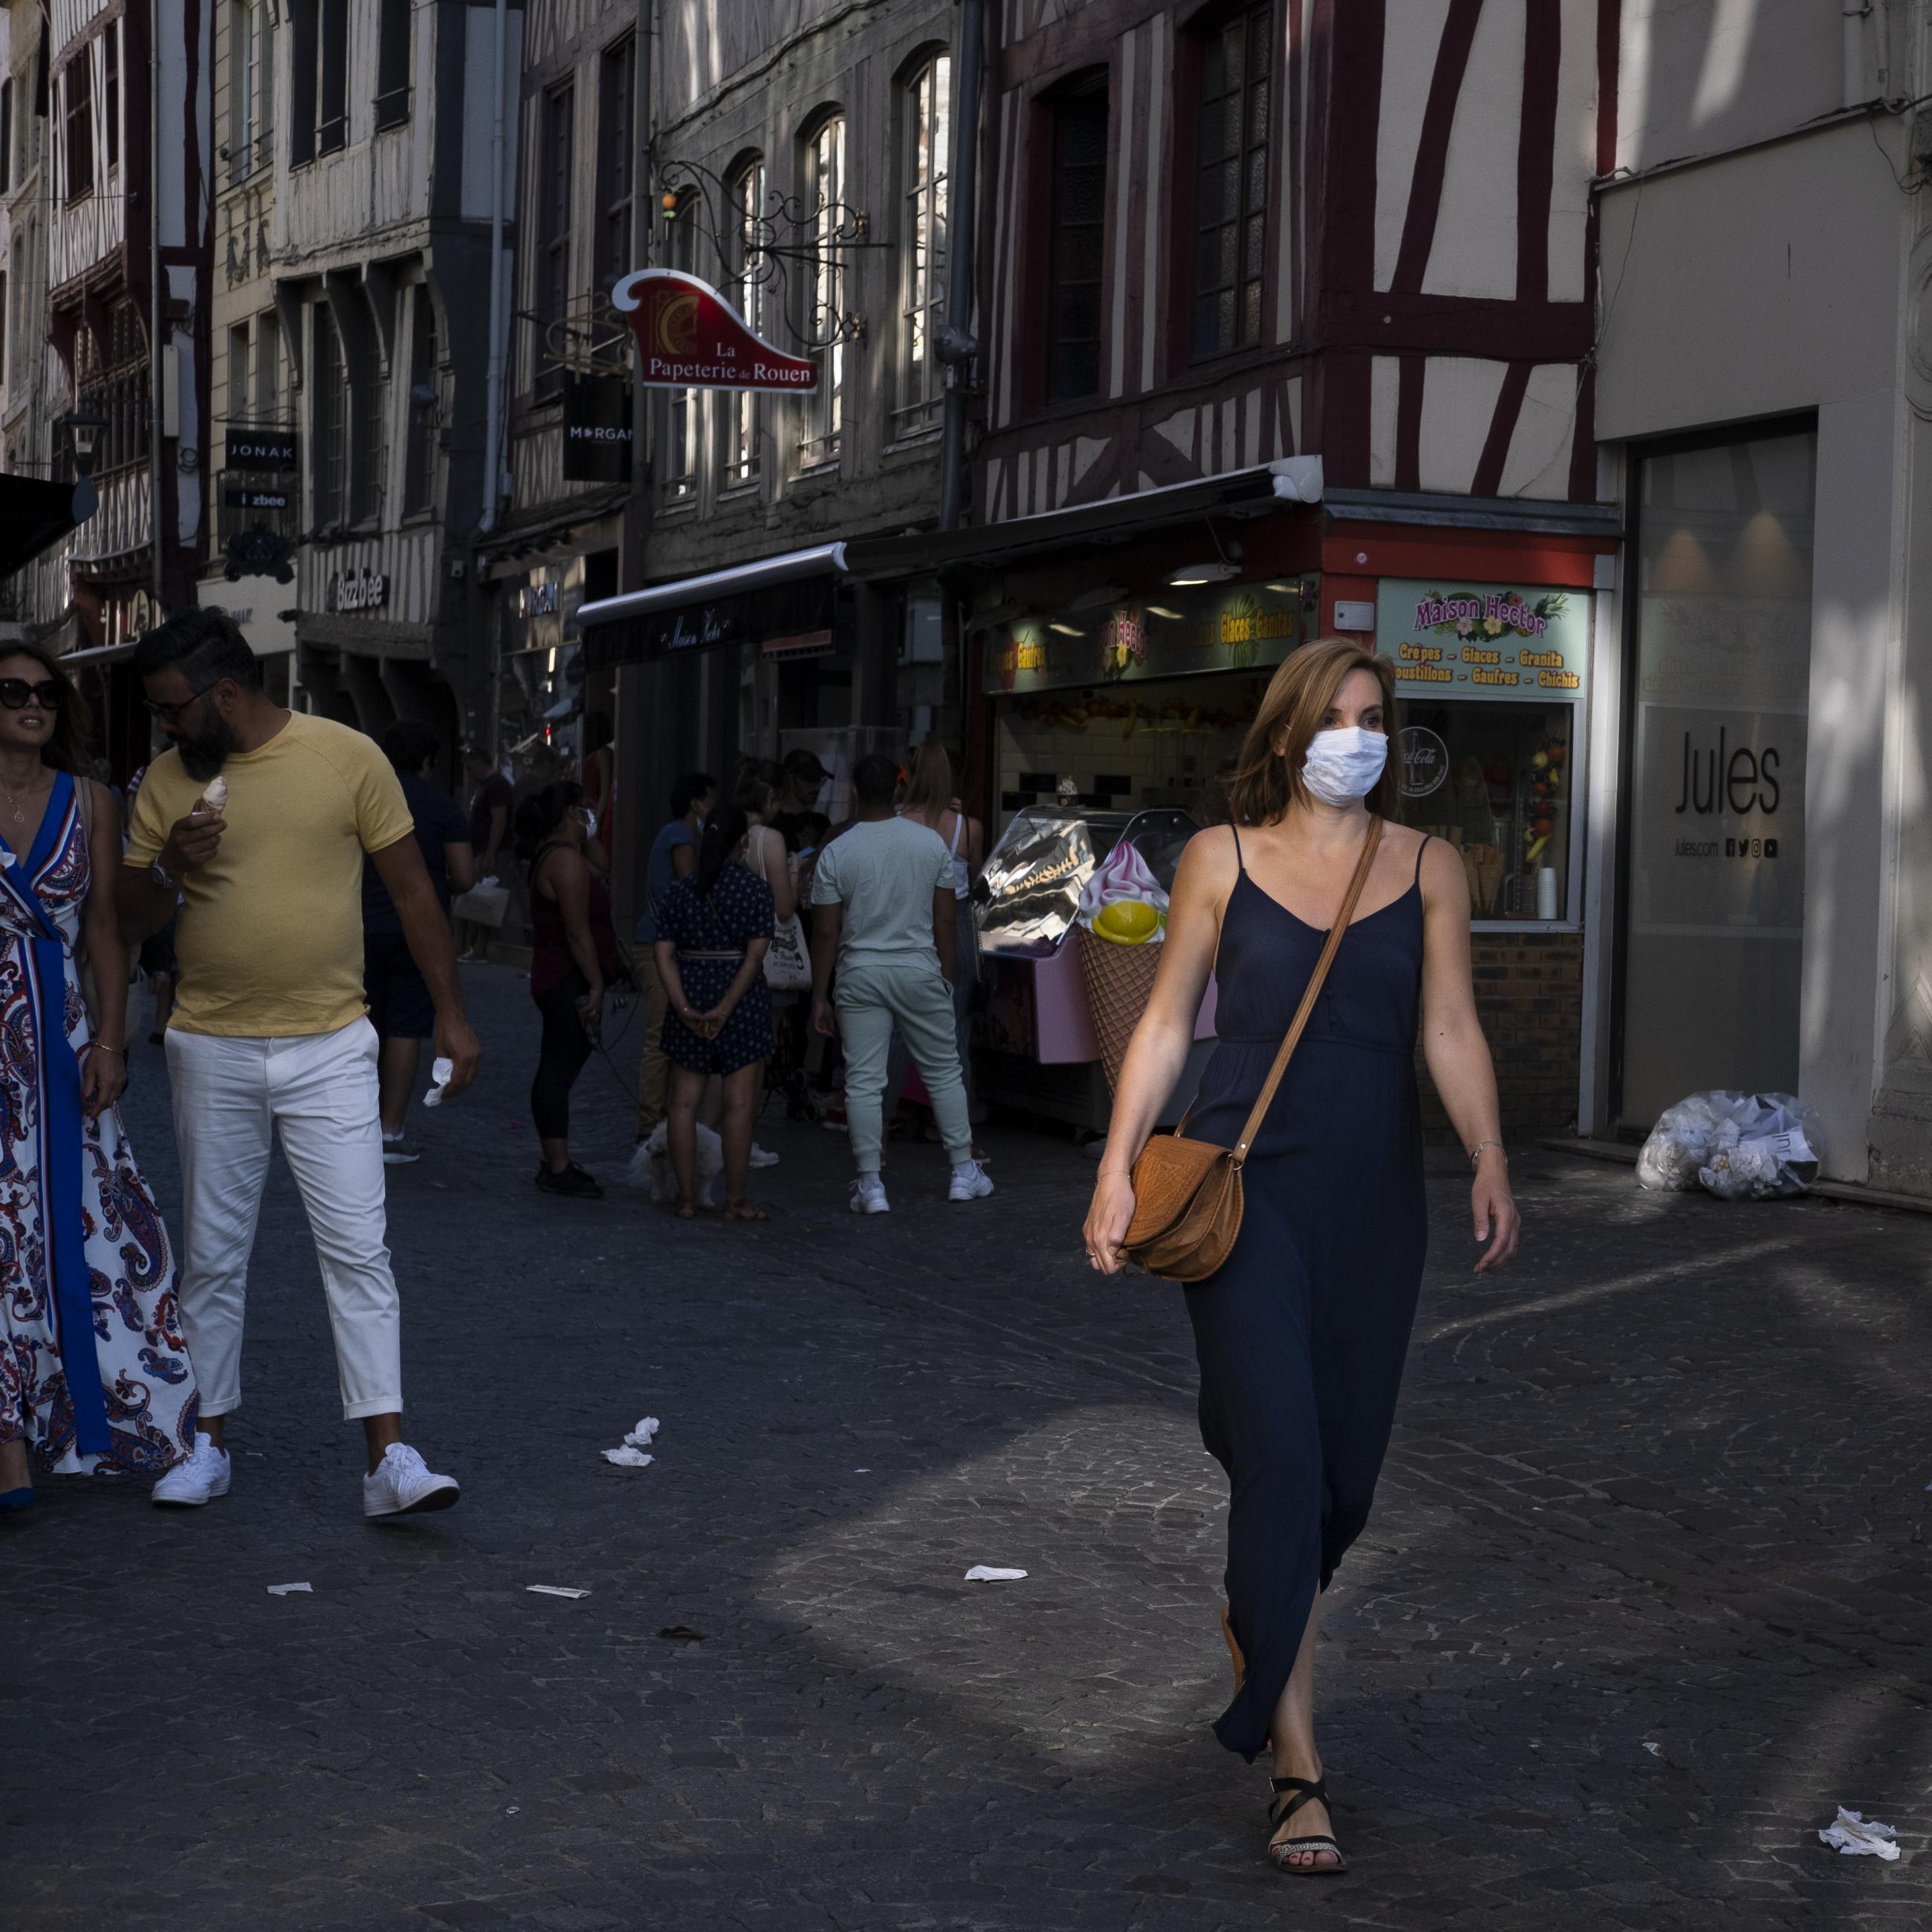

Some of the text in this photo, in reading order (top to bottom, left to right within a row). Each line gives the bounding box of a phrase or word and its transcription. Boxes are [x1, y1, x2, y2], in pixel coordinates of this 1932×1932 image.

[716, 342, 736, 357] La
[649, 357, 811, 382] Papeterie de Rouen
[231, 444, 294, 458] JONAK
[1219, 611, 1251, 644] Glaces
[1413, 594, 1546, 637] Maison Hector
[1398, 642, 1442, 664] Crêpes
[1462, 646, 1500, 664] Glaces
[1520, 649, 1563, 668] Granita
[1472, 667, 1519, 686] Gaufres
[1538, 671, 1580, 689] Chichis
[1676, 725, 1780, 814] Jules
[1675, 838, 1719, 857] Jules.com
